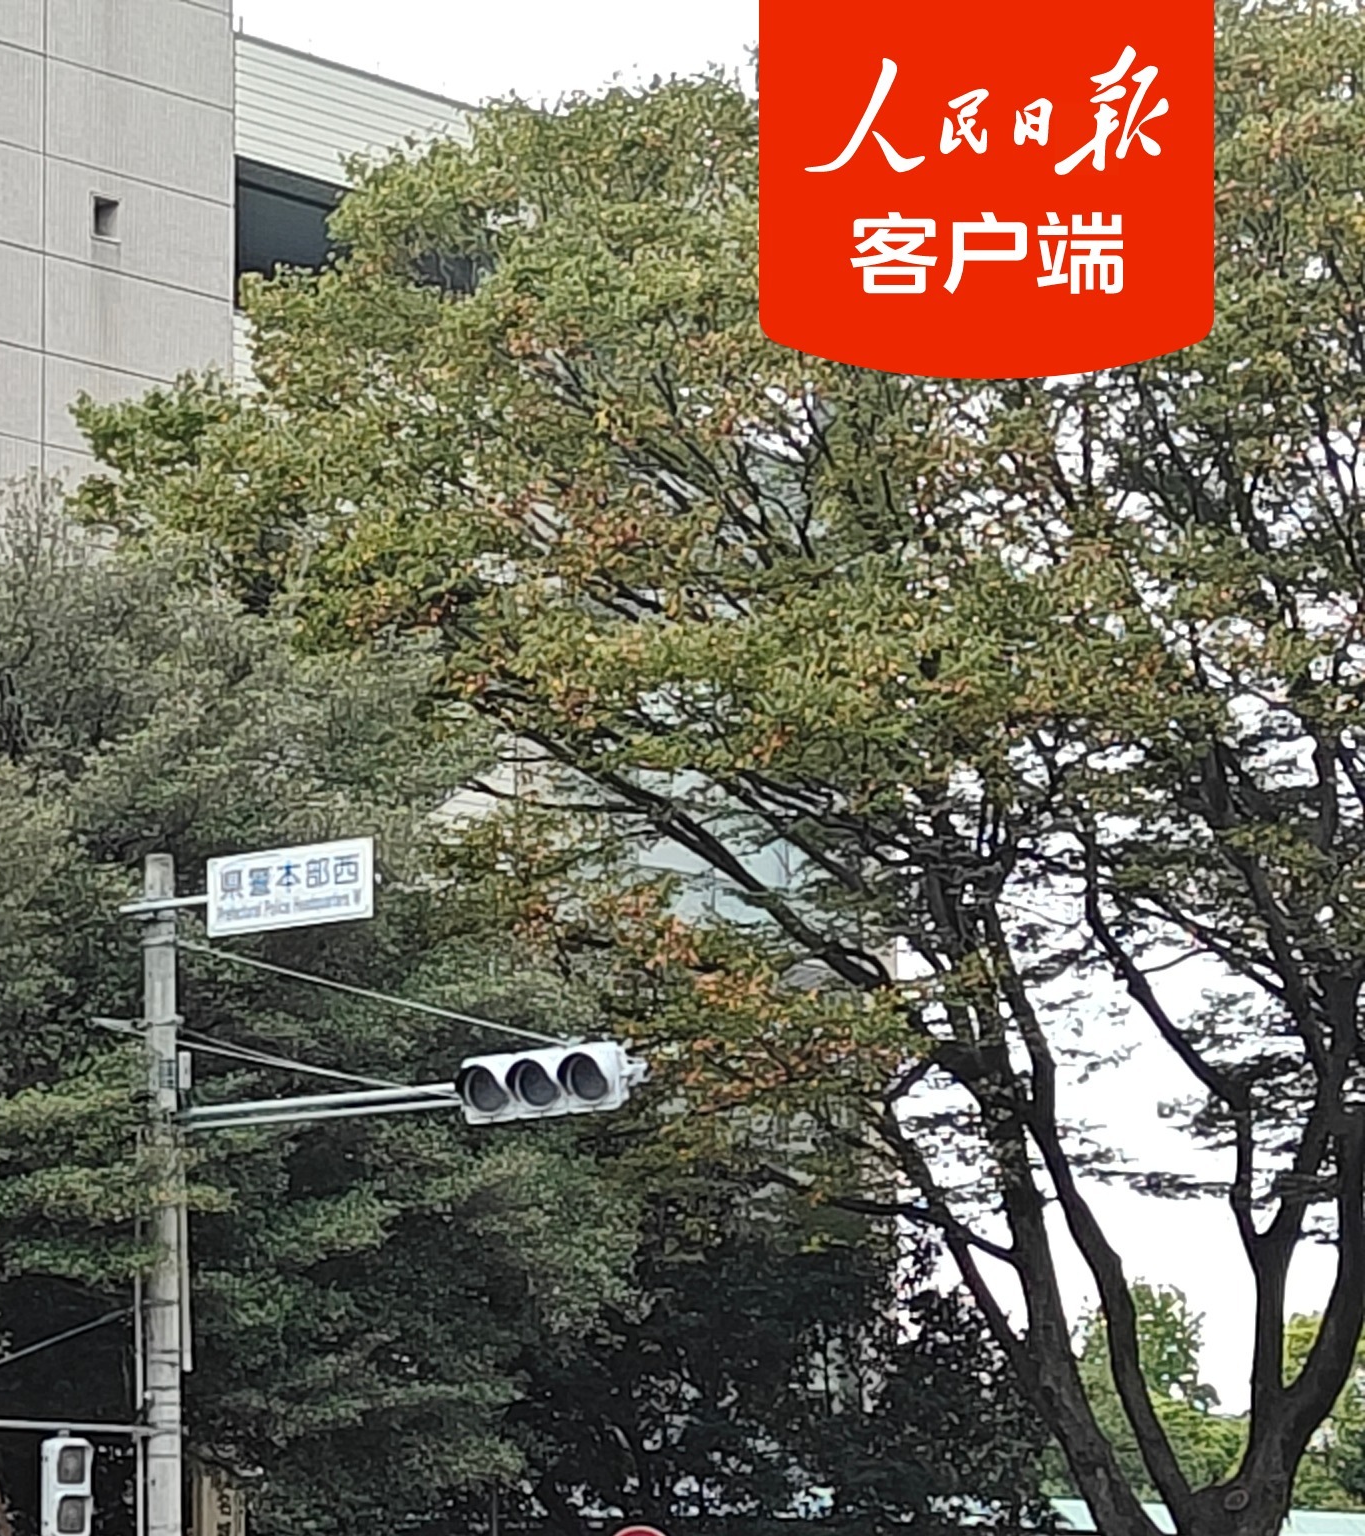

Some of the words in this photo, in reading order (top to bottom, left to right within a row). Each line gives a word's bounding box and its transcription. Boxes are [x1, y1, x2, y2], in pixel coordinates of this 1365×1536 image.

[220, 854, 360, 900] 県警本部西
